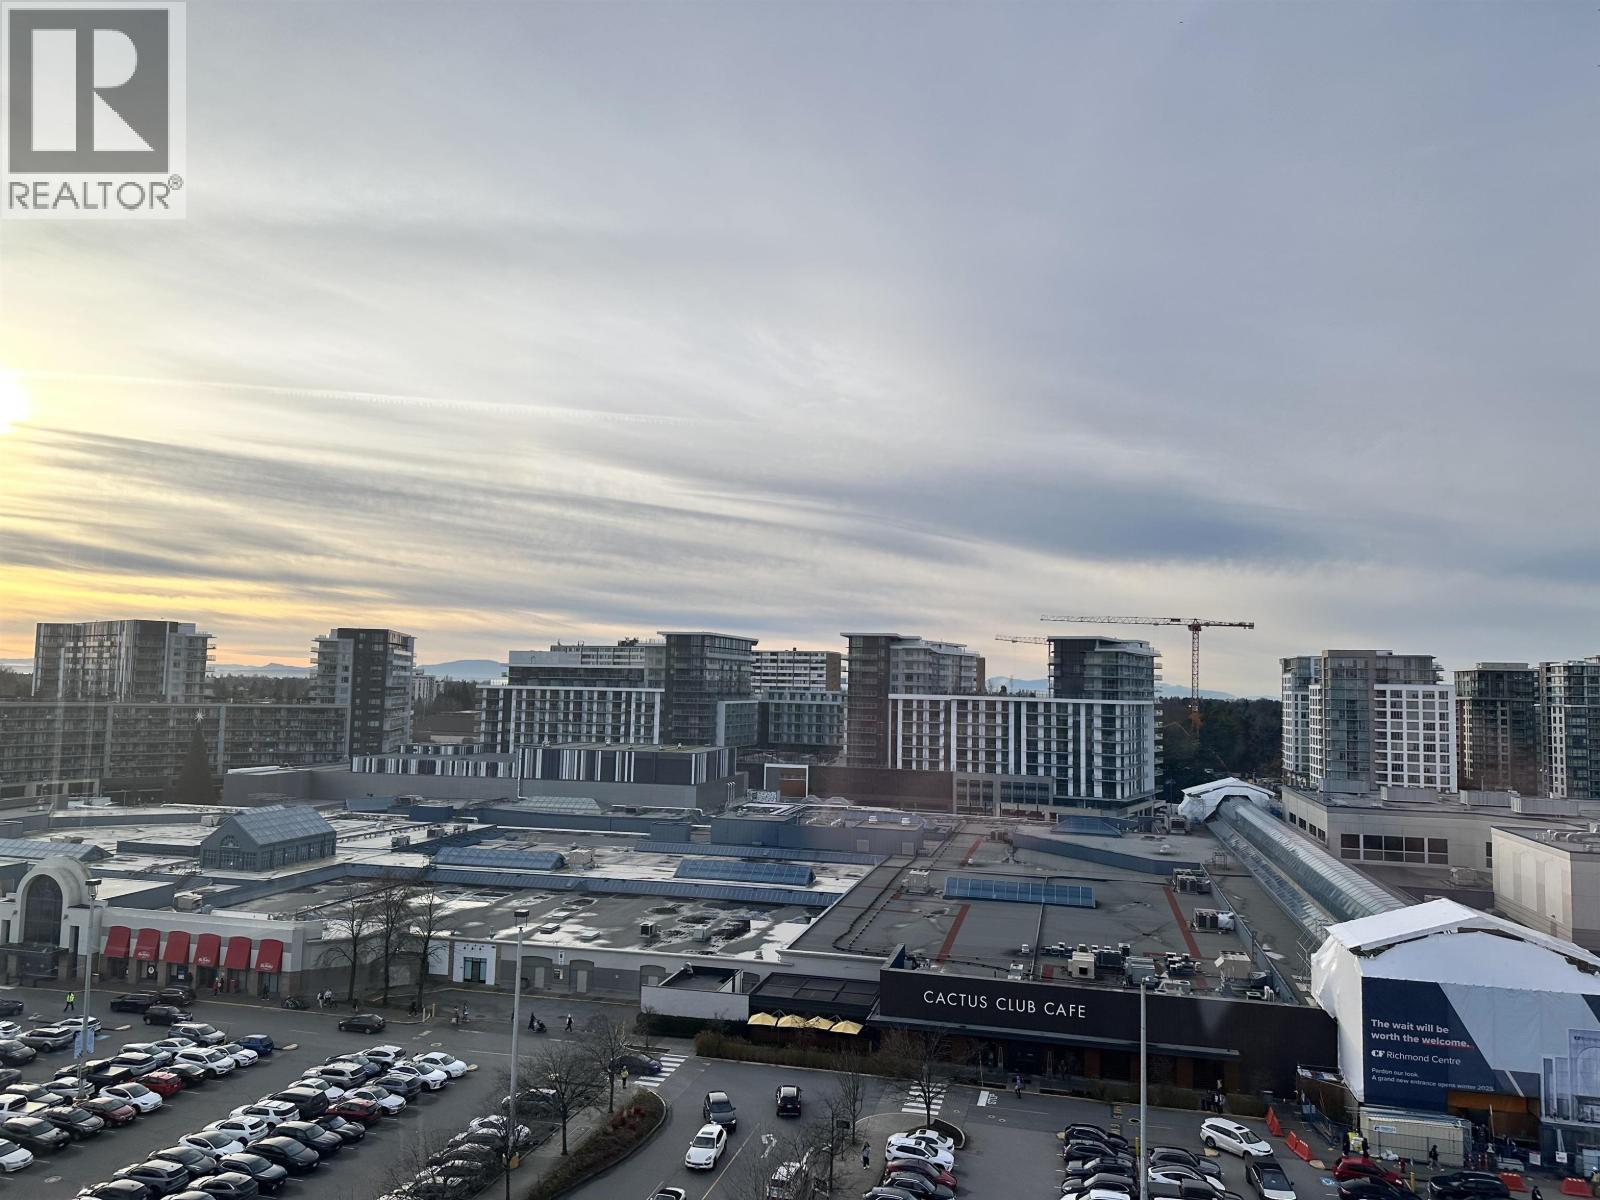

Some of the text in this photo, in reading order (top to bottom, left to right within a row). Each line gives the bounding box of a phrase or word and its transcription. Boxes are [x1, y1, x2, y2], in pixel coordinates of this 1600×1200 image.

[923, 990, 1086, 1018] CACTUS CLUB CAFE
[1371, 1018, 1449, 1034] The wait will be
[1371, 1032, 1470, 1047] worth the welcome.
[1371, 1049, 1461, 1065] CF Richmond Centre
